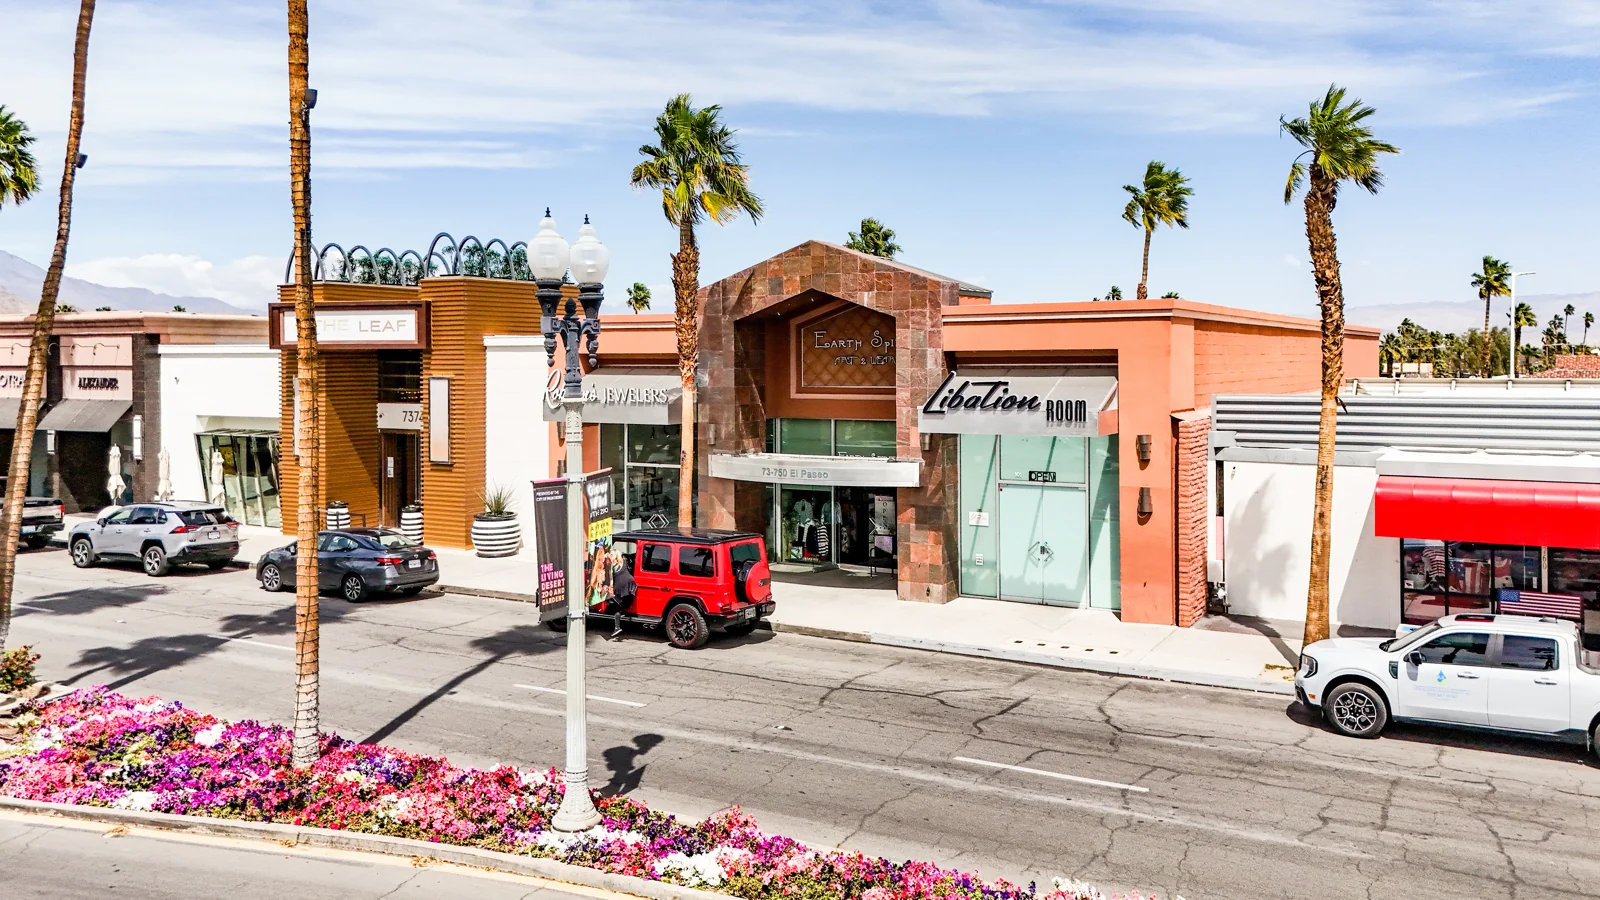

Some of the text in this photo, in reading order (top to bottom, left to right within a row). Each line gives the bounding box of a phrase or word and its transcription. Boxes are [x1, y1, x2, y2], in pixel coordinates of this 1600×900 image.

[358, 319, 407, 333] LEAF
[814, 330, 896, 353] EARTH SPI
[602, 387, 668, 404] JEWELERS
[922, 370, 1087, 422] Libation ROOM
[761, 467, 829, 479] 73-750 El Paseo
[1030, 471, 1055, 481] OPEN
[541, 563, 554, 572] THE
[541, 570, 563, 582] LIVING
[541, 578, 565, 591] DESERT
[541, 587, 565, 598] ZOO AND
[541, 594, 565, 605] GARDENS
